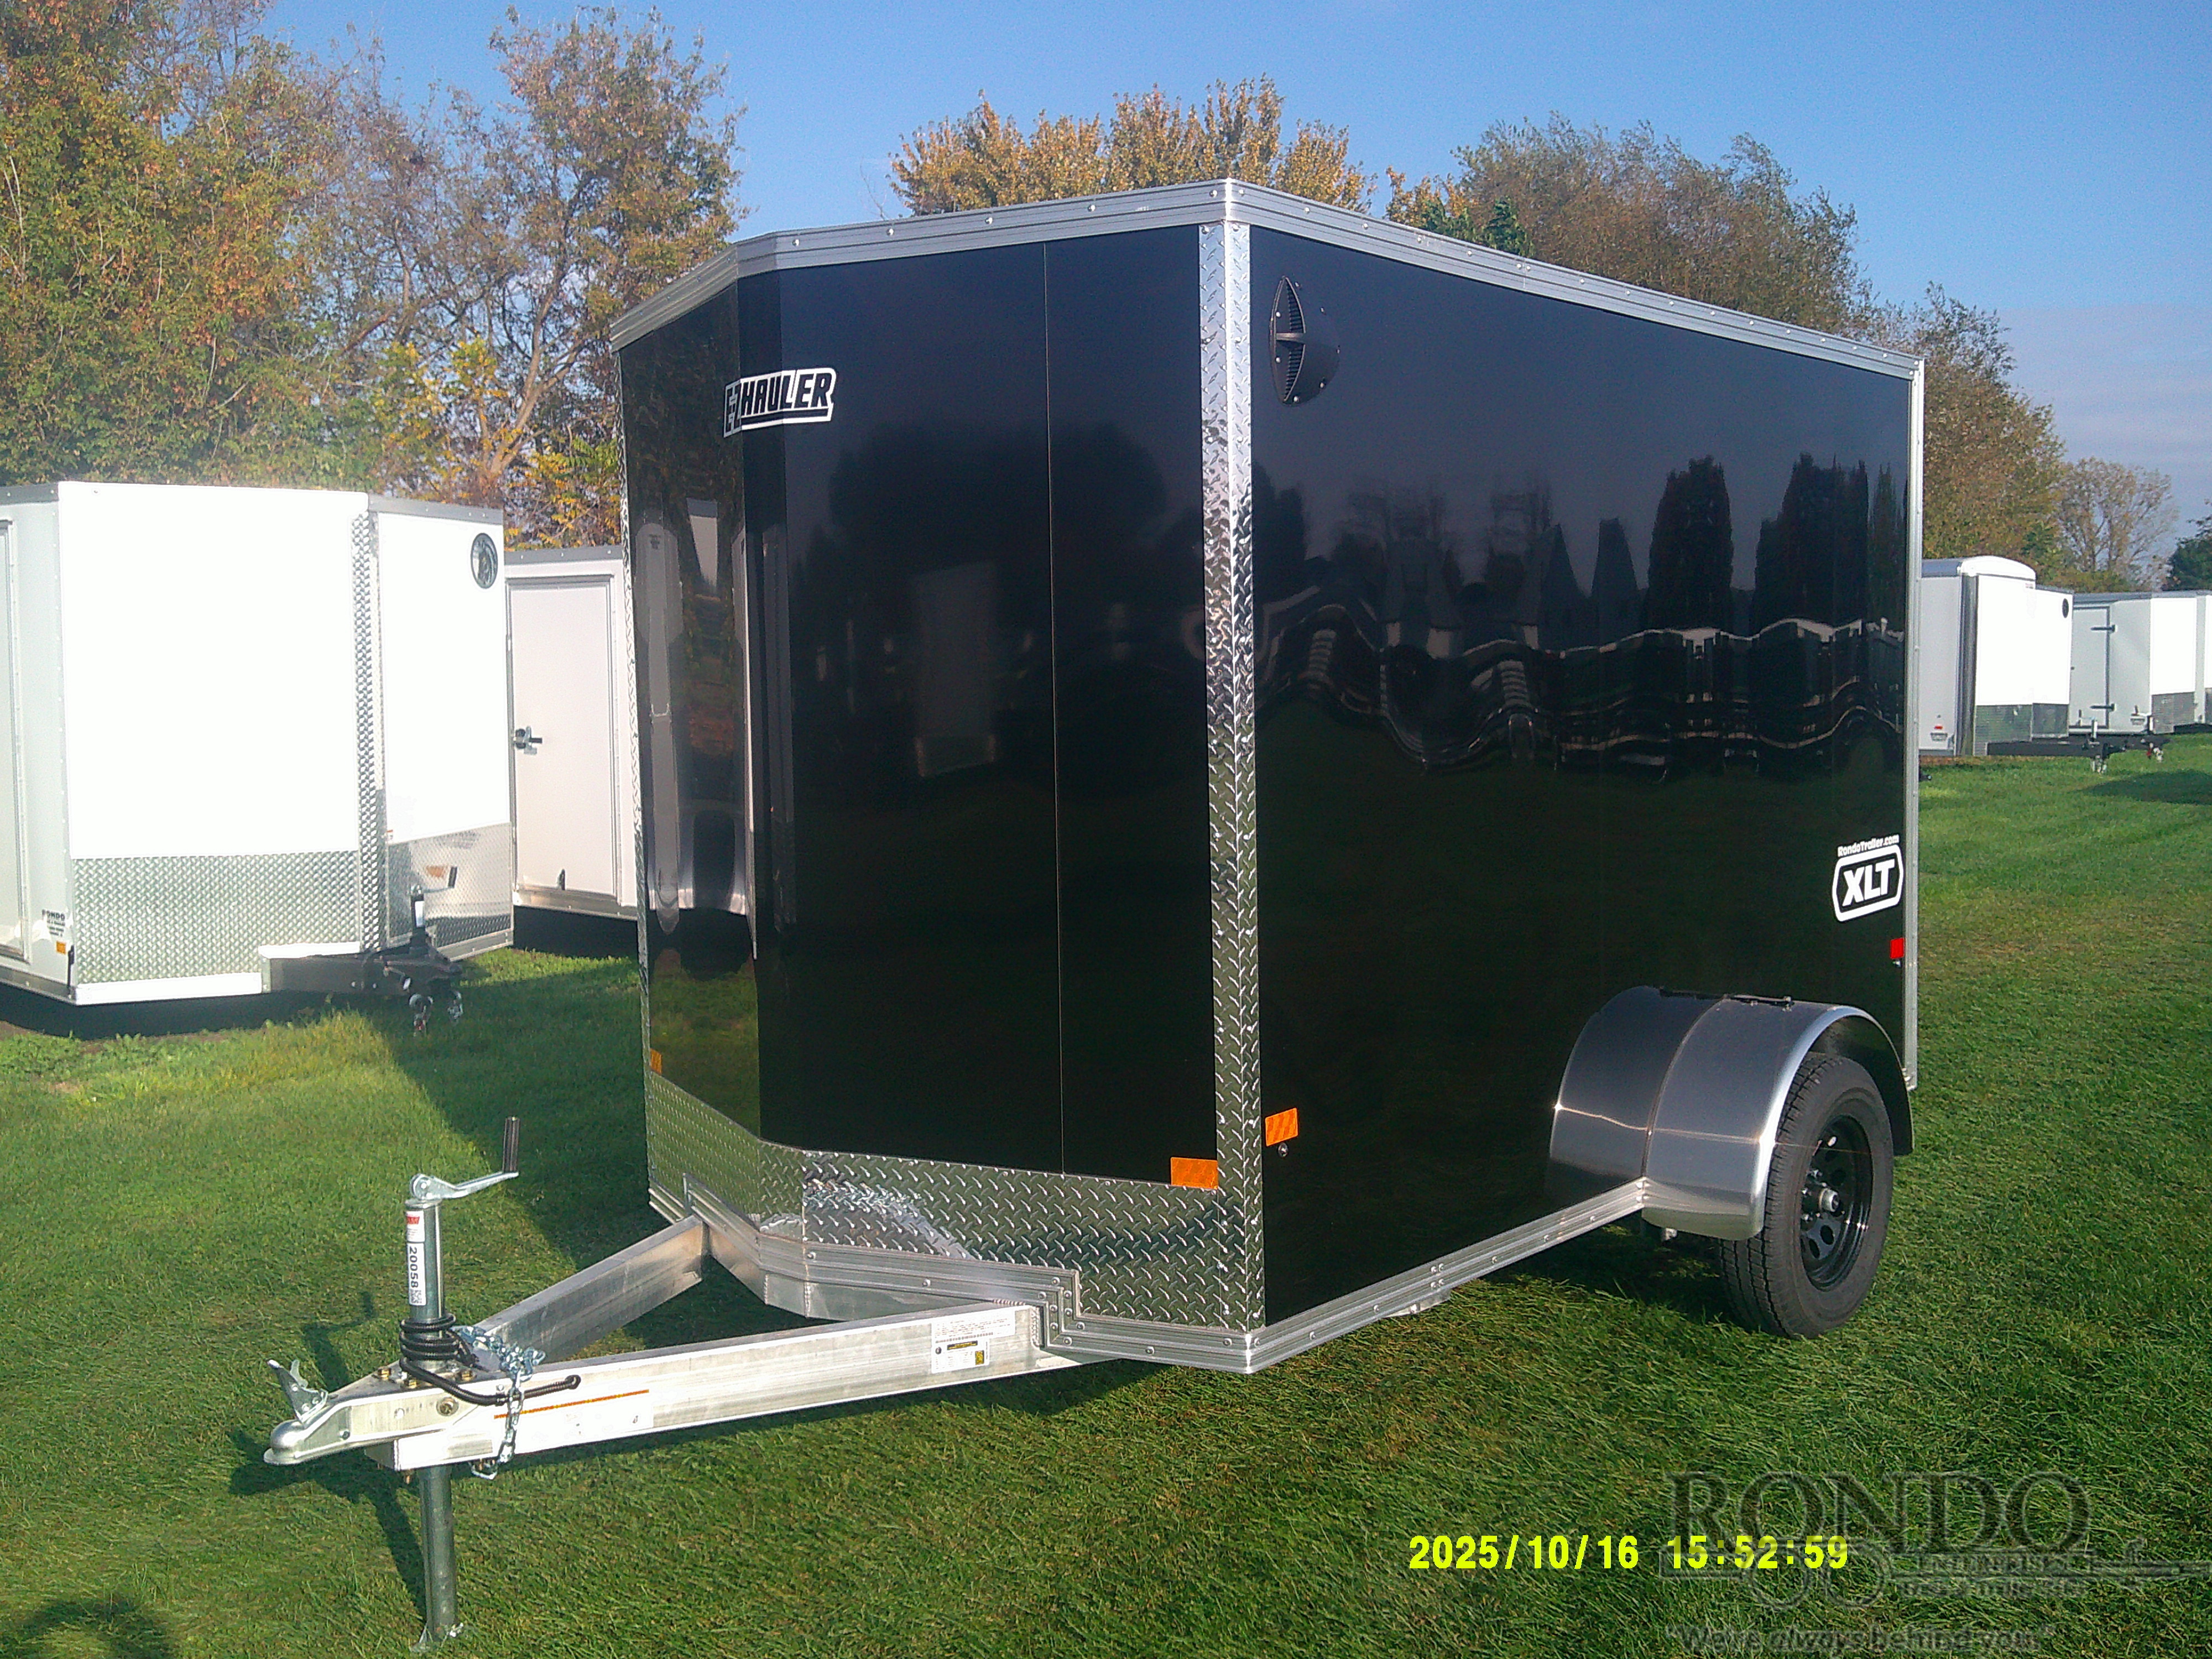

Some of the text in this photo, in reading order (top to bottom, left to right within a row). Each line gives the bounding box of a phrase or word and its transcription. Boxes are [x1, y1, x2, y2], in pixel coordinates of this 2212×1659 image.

[742, 372, 832, 416] HAULER
[1838, 834, 1899, 857] RondoTrailer.com
[1842, 858, 1895, 906] XLT
[409, 1246, 419, 1288] 20058
